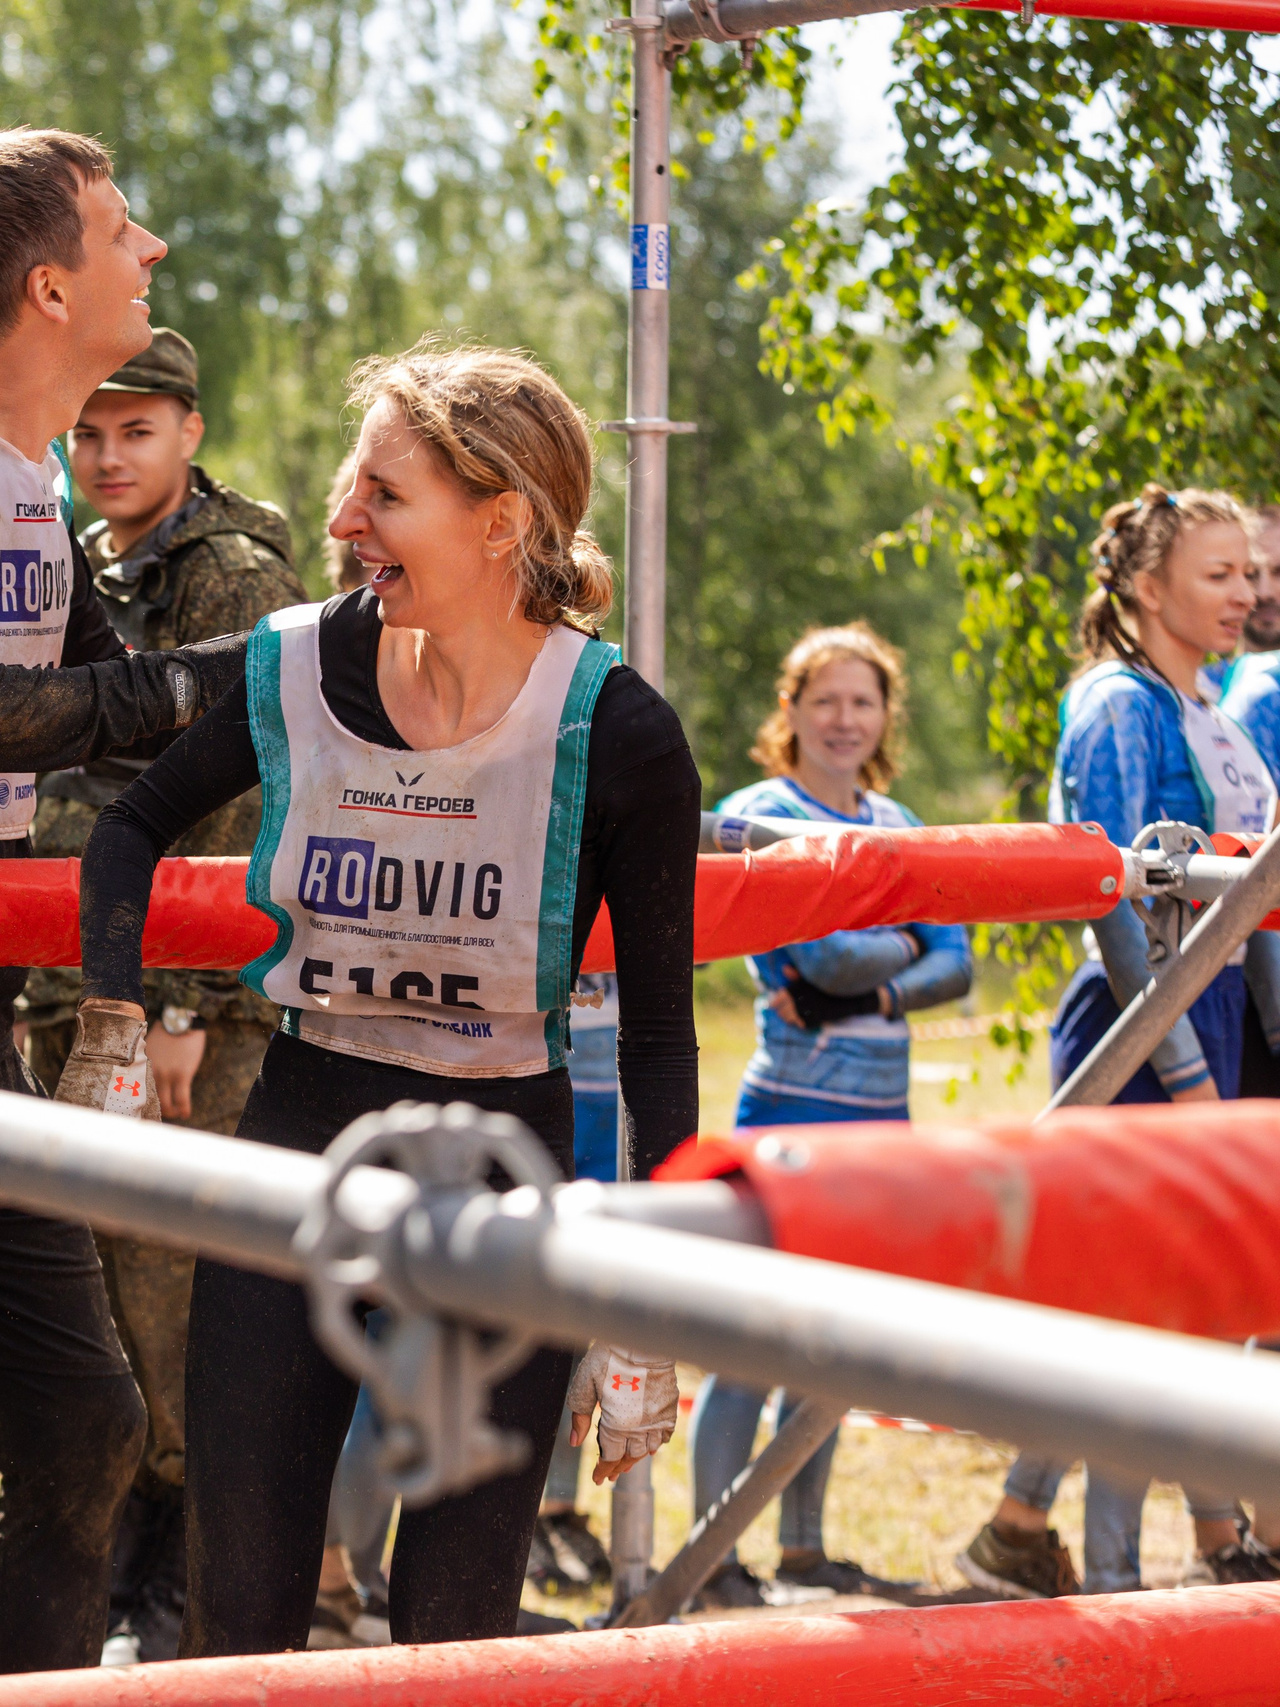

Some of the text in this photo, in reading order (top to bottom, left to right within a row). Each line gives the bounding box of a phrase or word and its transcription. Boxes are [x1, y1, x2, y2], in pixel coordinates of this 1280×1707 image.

[16, 503, 46, 517] ГОНКА
[1, 558, 67, 612] RODVG
[175, 673, 186, 710] GRAVITY
[343, 789, 475, 813] ГОНКА ГЕРОЕВ
[303, 848, 503, 921] RODVIG
[333, 923, 348, 934] ДЛЯ
[407, 932, 462, 946] БЛАГОСОСТОЯНИЕ
[463, 936, 478, 946] ДЛЯ
[478, 937, 495, 948] ВСЕХ
